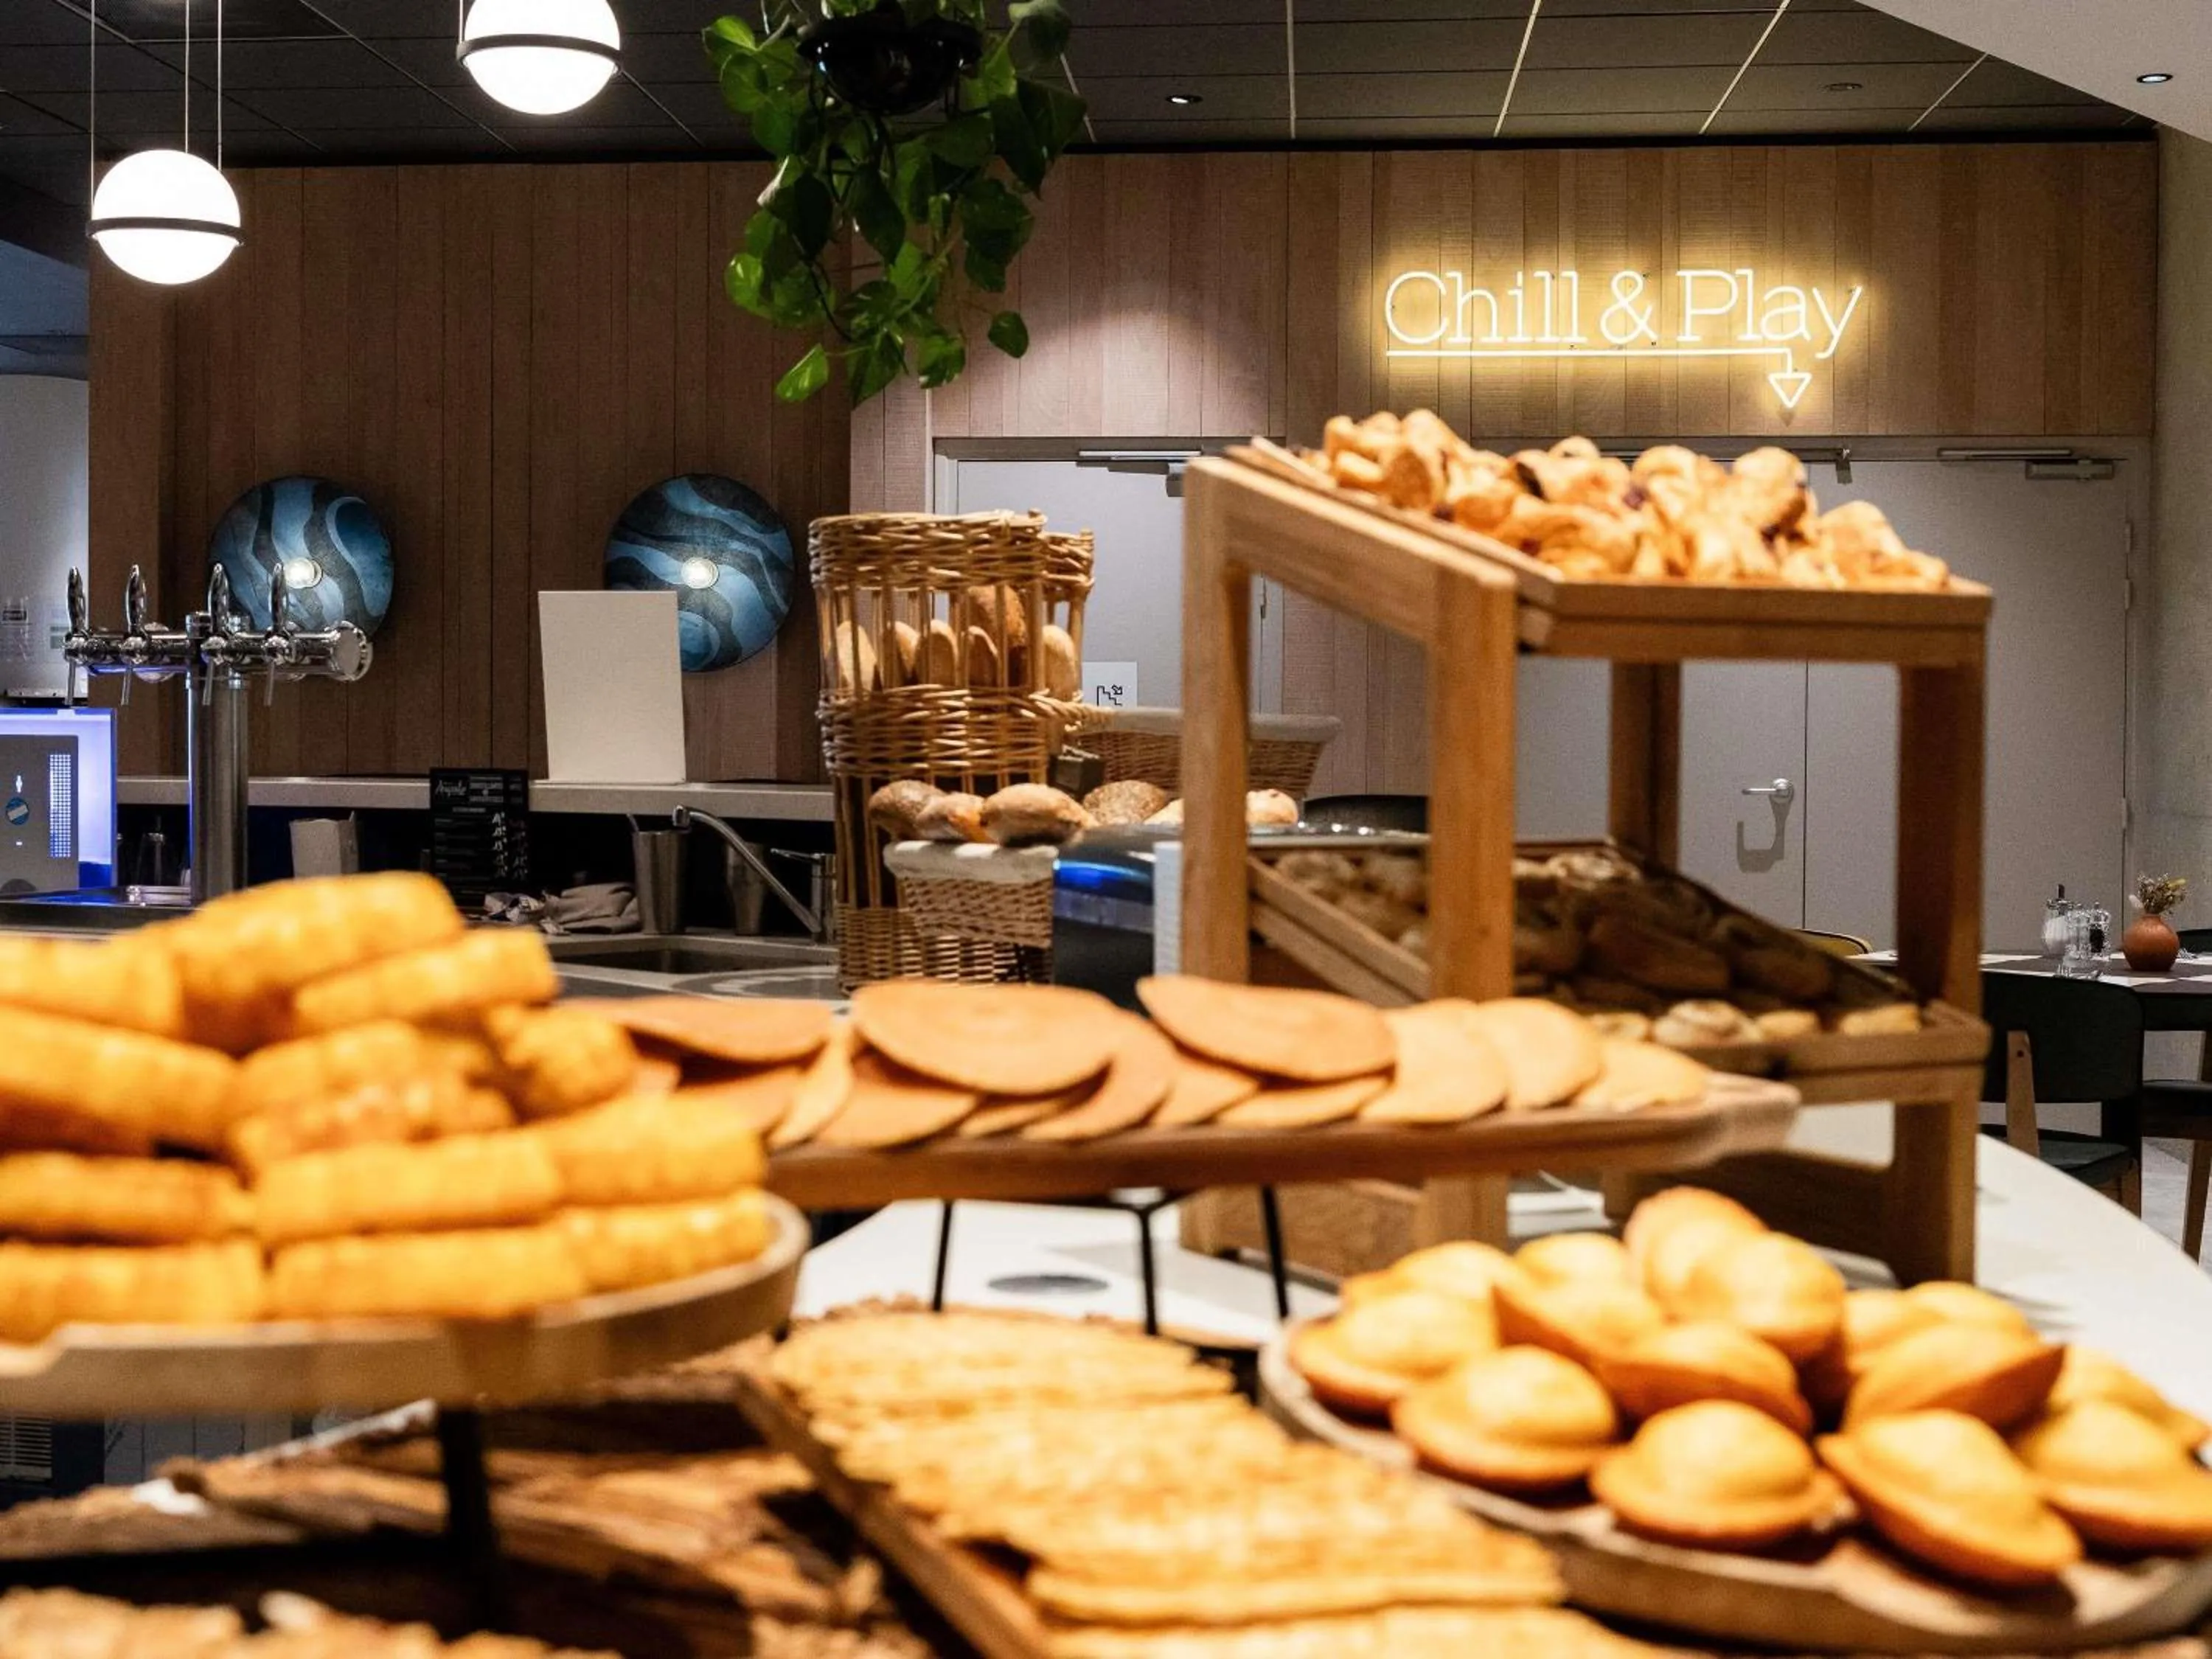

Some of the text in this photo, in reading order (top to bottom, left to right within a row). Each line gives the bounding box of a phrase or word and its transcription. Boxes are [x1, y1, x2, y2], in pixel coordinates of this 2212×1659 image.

[1385, 268, 1863, 359] Chill & Play
